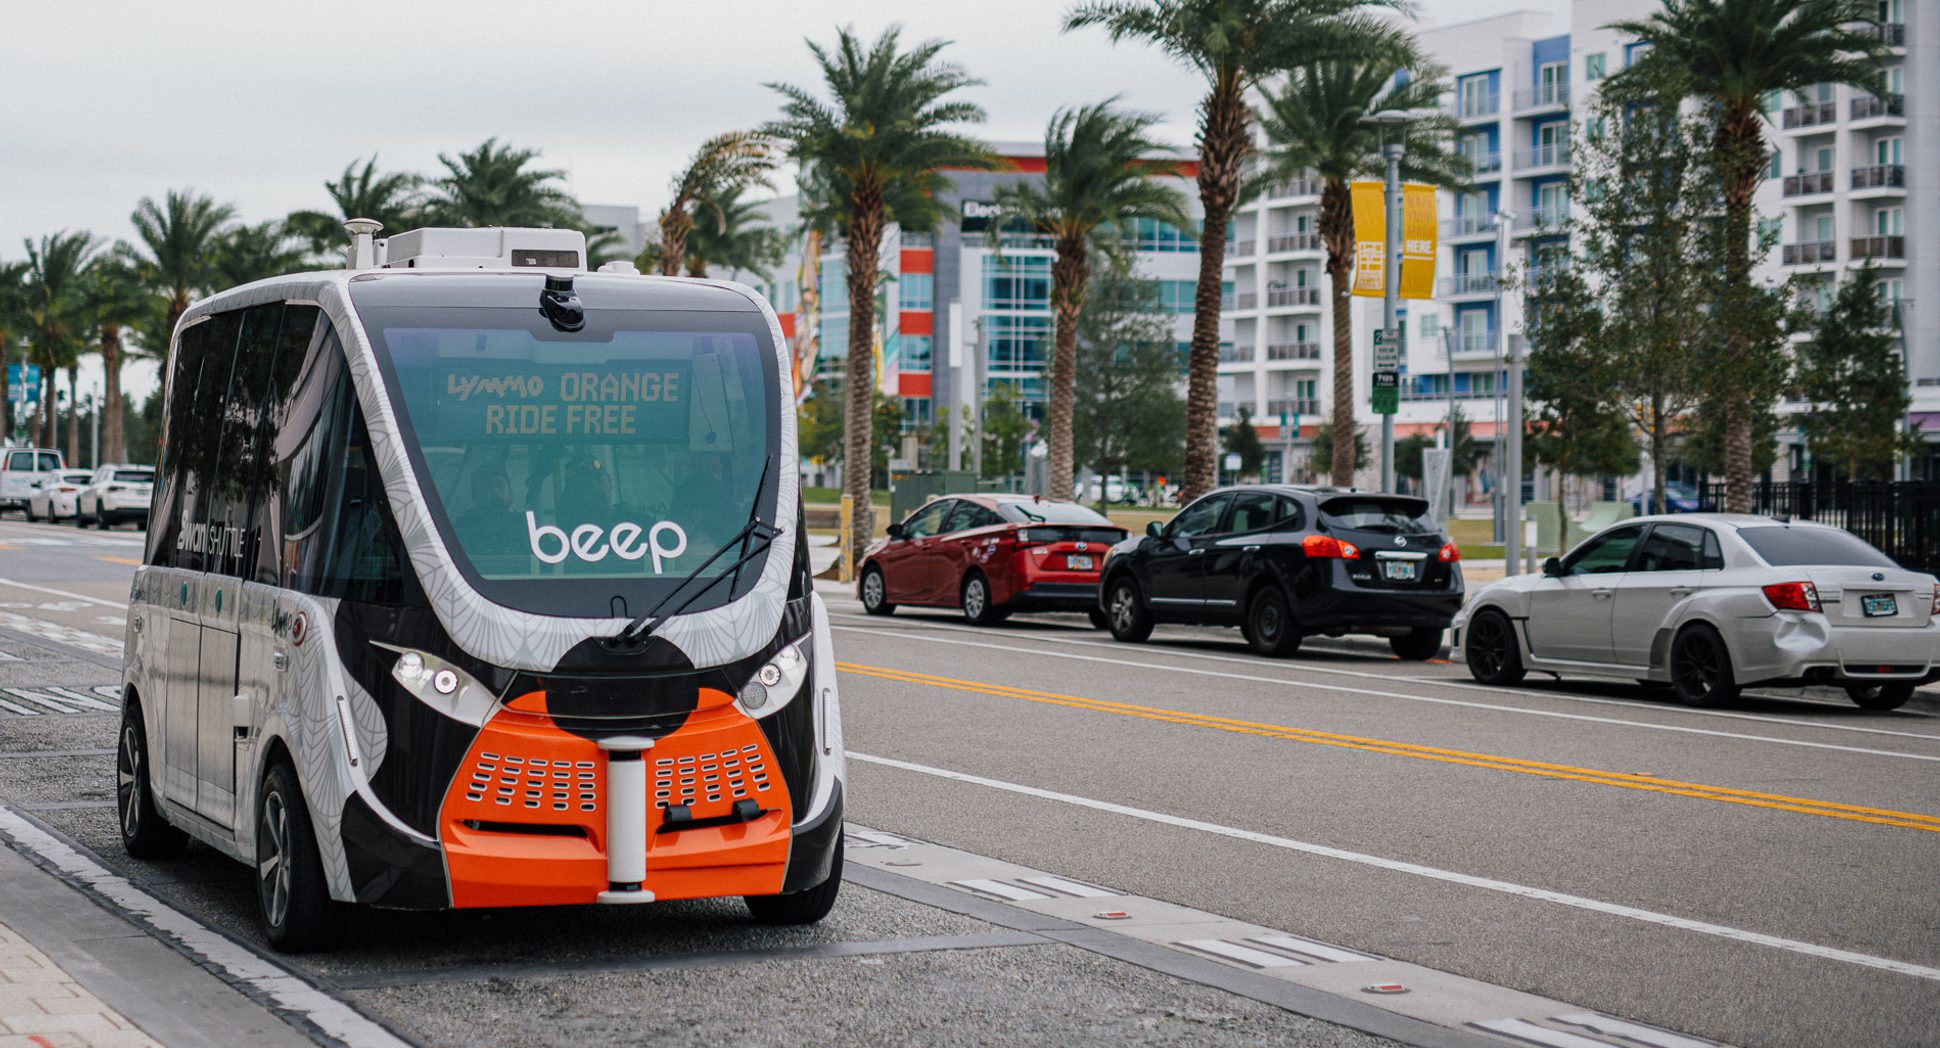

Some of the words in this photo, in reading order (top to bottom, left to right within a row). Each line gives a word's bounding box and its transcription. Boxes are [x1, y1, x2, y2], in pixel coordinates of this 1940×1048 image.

[1406, 240, 1433, 252] HERE
[560, 371, 679, 402] ORANGE
[485, 404, 558, 435] RIDE
[566, 404, 638, 435] FREE
[208, 525, 246, 558] SHUTTLE
[525, 510, 688, 575] beep
